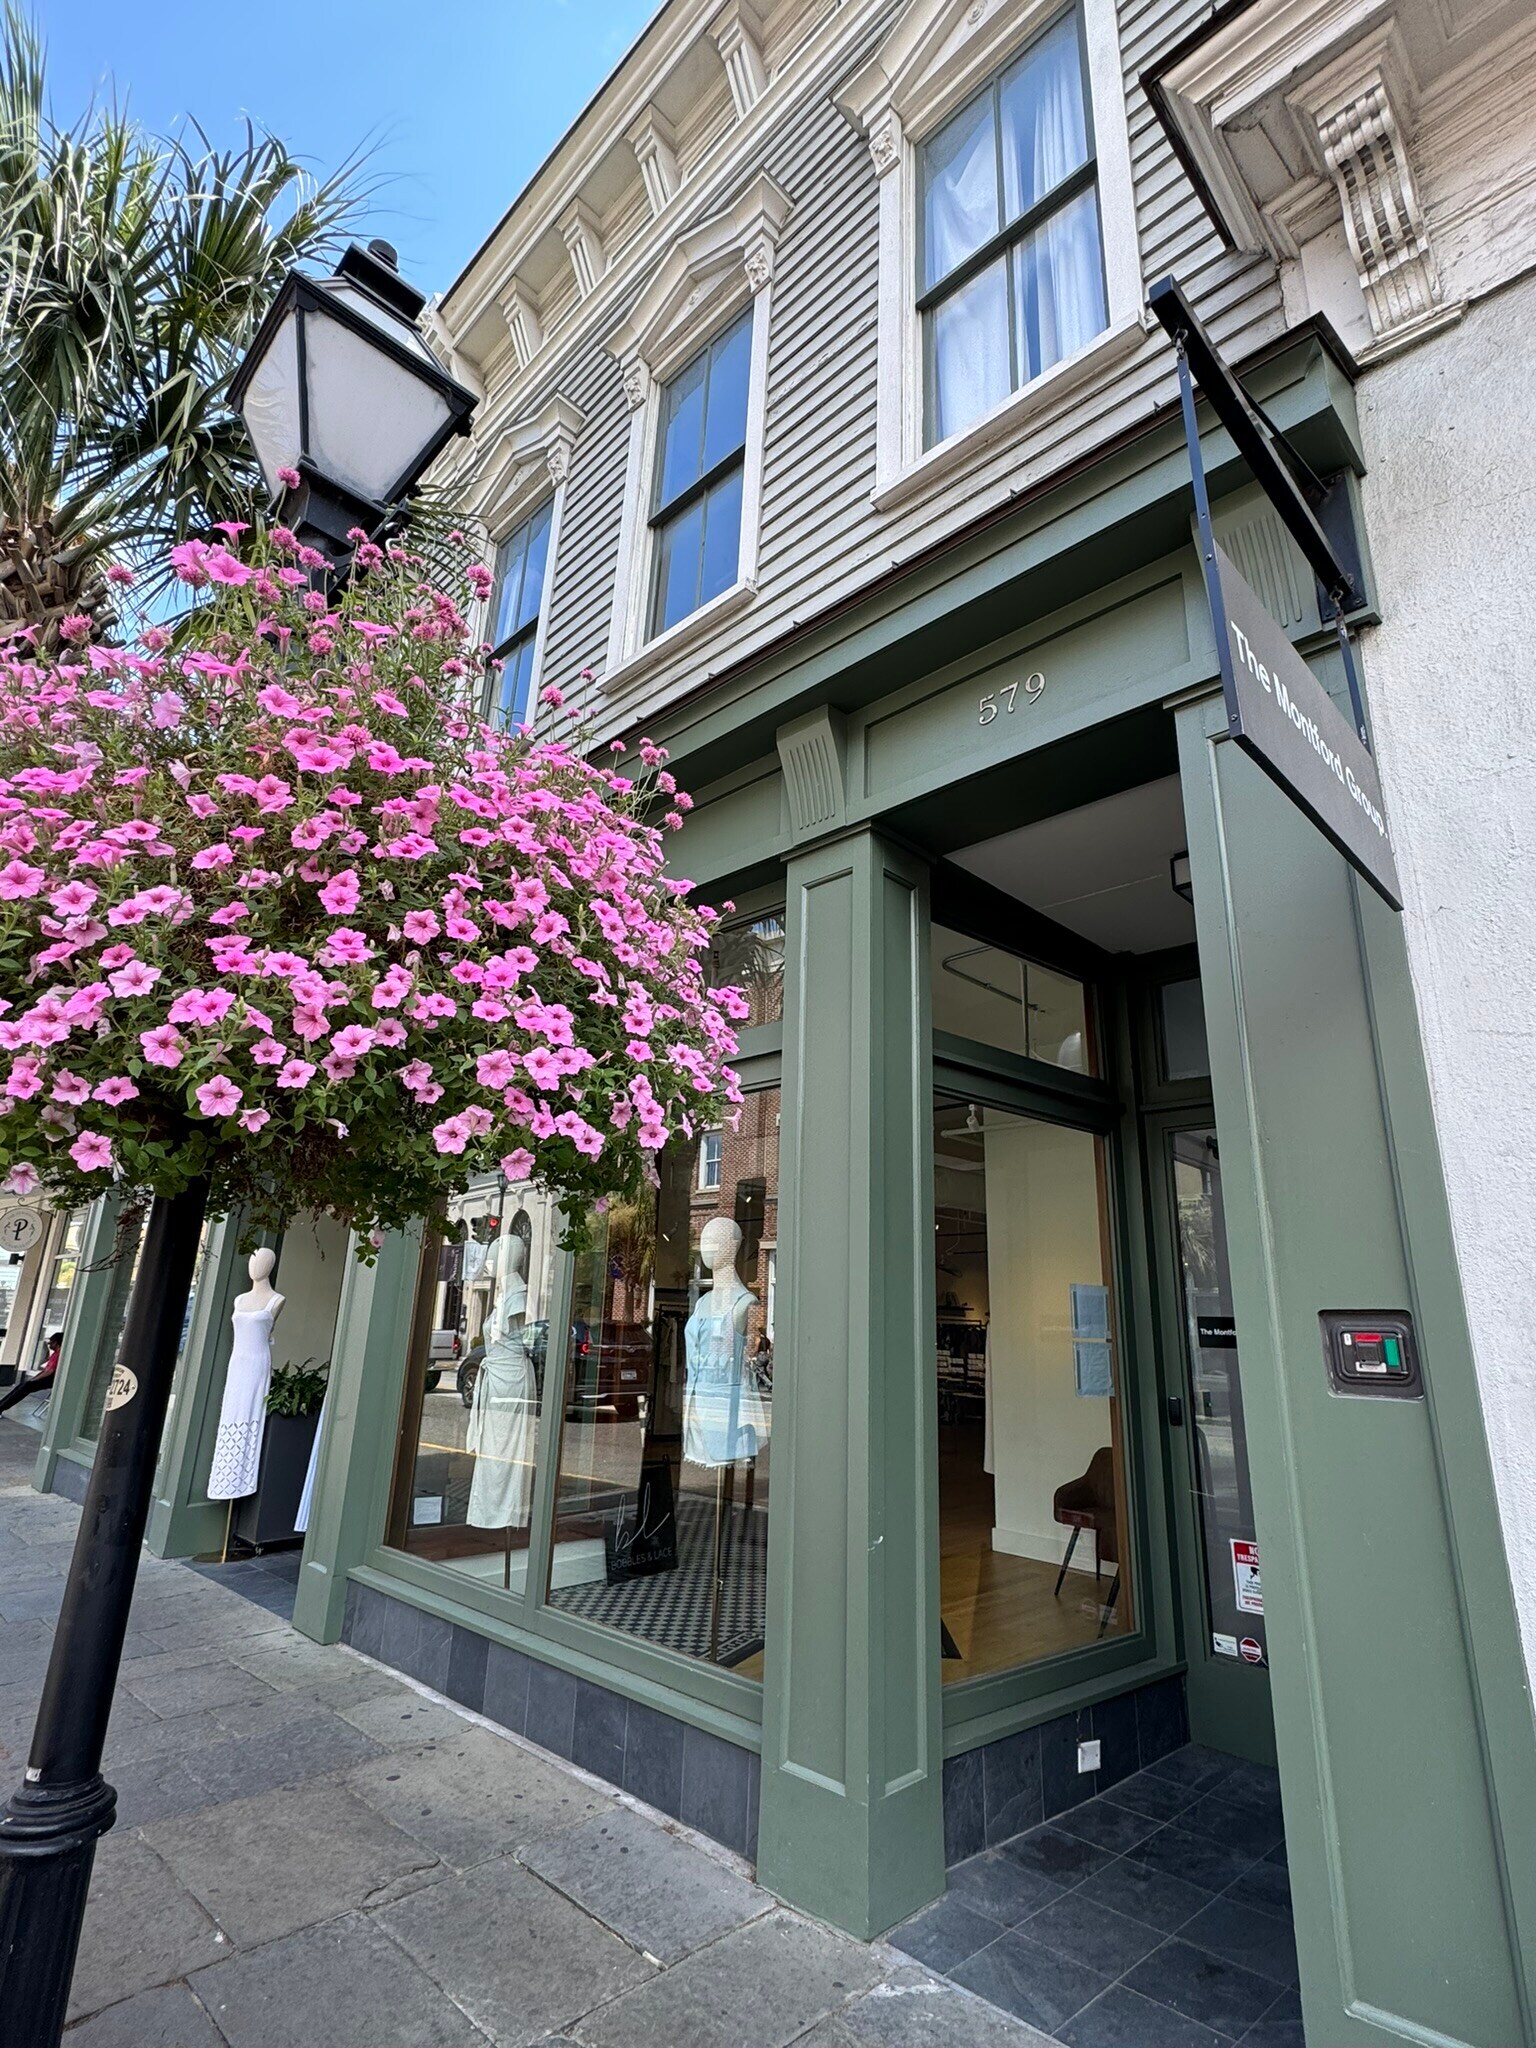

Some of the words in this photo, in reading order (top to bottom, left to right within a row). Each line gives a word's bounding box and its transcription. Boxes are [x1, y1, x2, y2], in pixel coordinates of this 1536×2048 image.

[979, 672, 1046, 726] 579
[1230, 620, 1272, 693] The
[1272, 672, 1346, 785] Montford
[1200, 1327, 1213, 1336] The
[610, 1553, 647, 1571] BOBBLES
[653, 1546, 673, 1561] LACE
